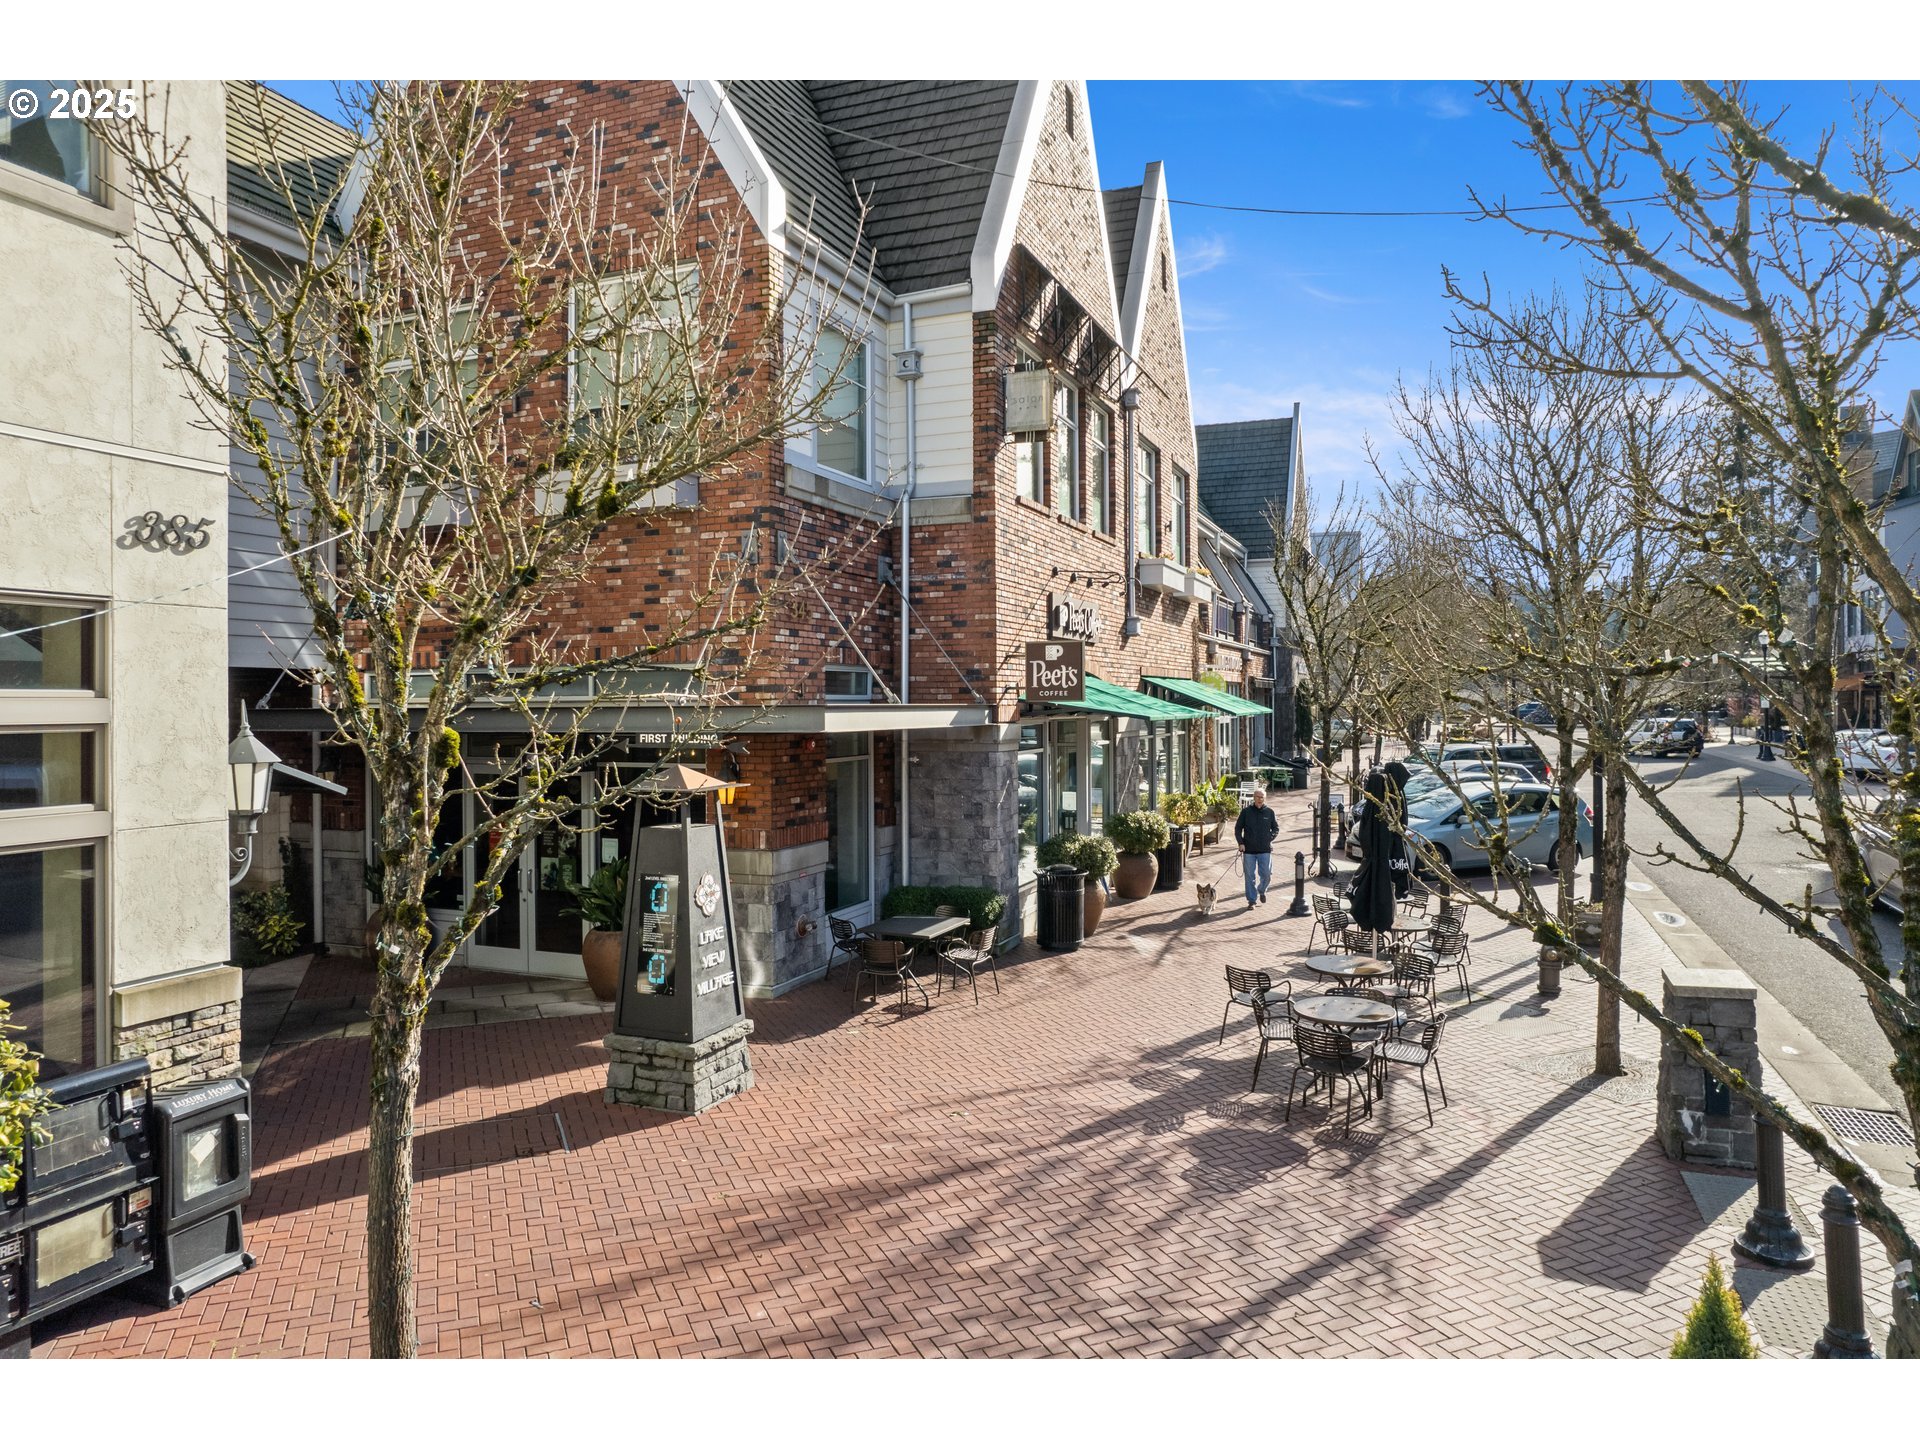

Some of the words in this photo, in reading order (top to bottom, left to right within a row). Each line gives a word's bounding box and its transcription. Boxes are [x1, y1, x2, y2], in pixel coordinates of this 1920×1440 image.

[1010, 394, 1044, 406] salon
[135, 510, 216, 550] 385
[1029, 660, 1078, 689] Peet's
[639, 733, 667, 744] FIRST
[1391, 858, 1409, 871] Coffe
[699, 926, 725, 946] LAKE
[702, 949, 726, 968] VIEW
[697, 971, 734, 997] VILLAGE
[172, 1092, 207, 1109] LUXURY
[207, 1083, 236, 1099] HOME
[0, 1240, 22, 1259] REE
